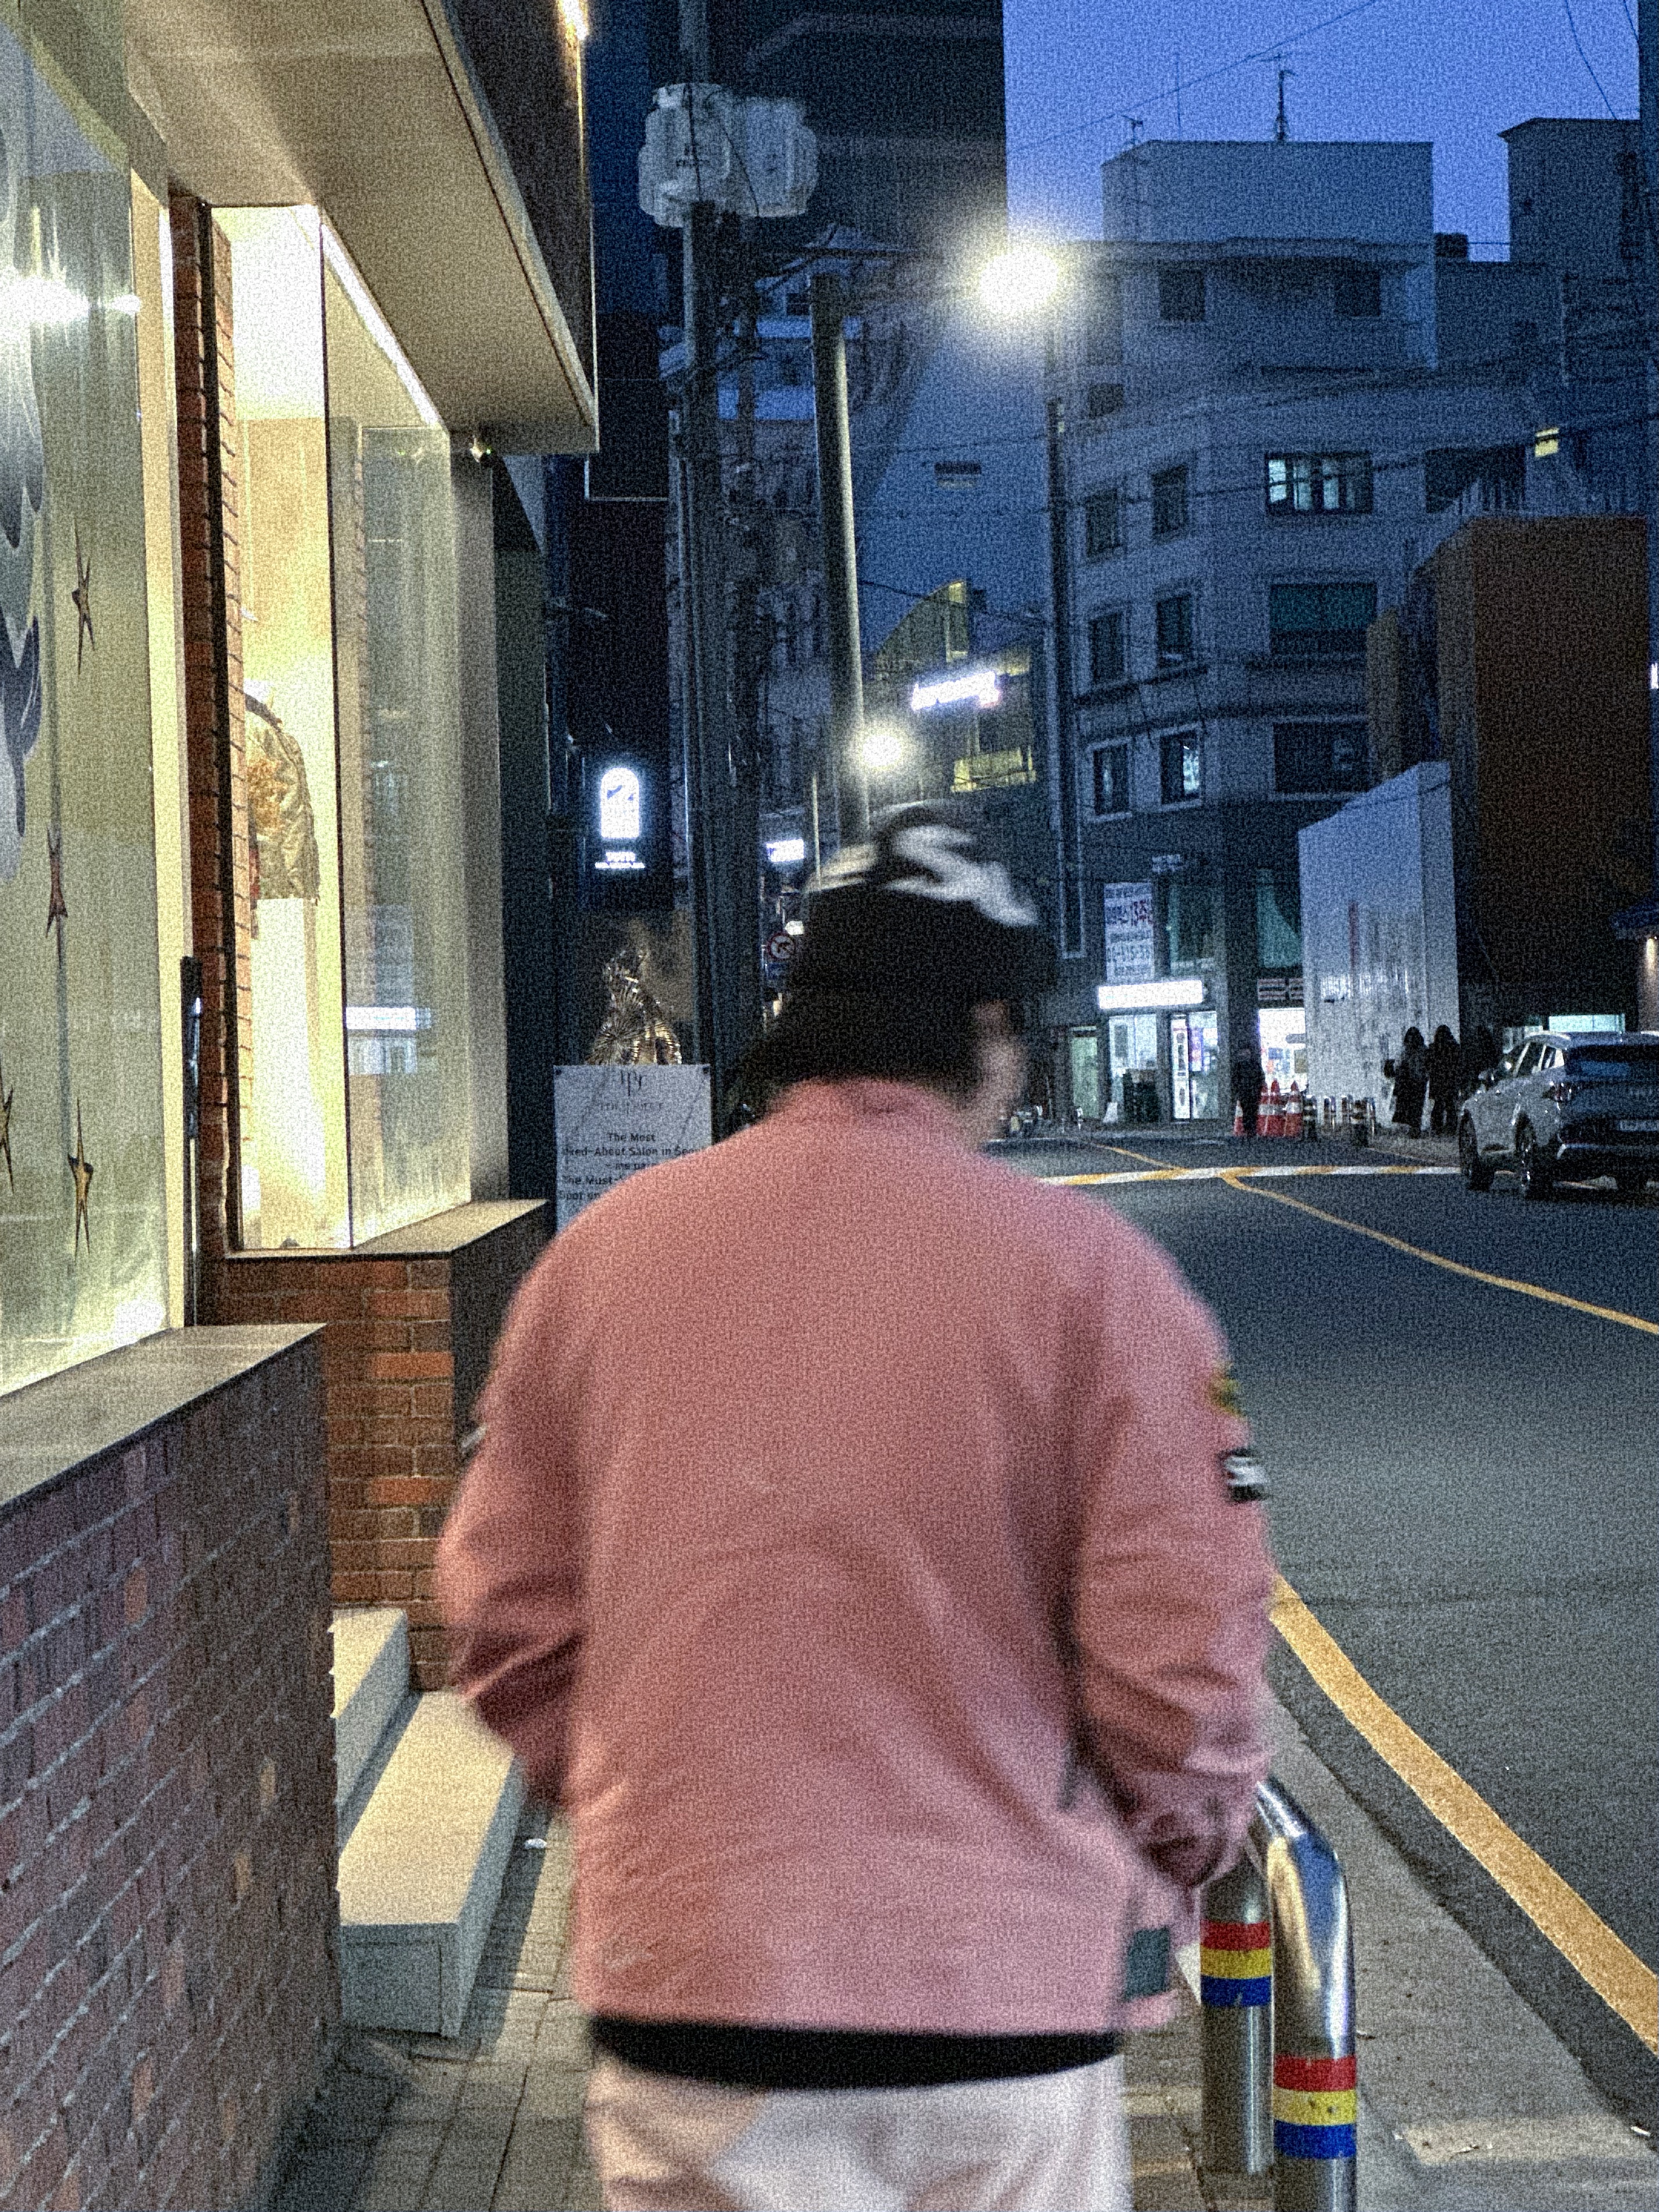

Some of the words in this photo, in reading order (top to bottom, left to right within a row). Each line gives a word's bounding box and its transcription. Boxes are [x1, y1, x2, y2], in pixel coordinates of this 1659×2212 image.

[608, 1132, 627, 1142] The
[630, 1132, 656, 1142] Most
[628, 1146, 658, 1156] Salon
